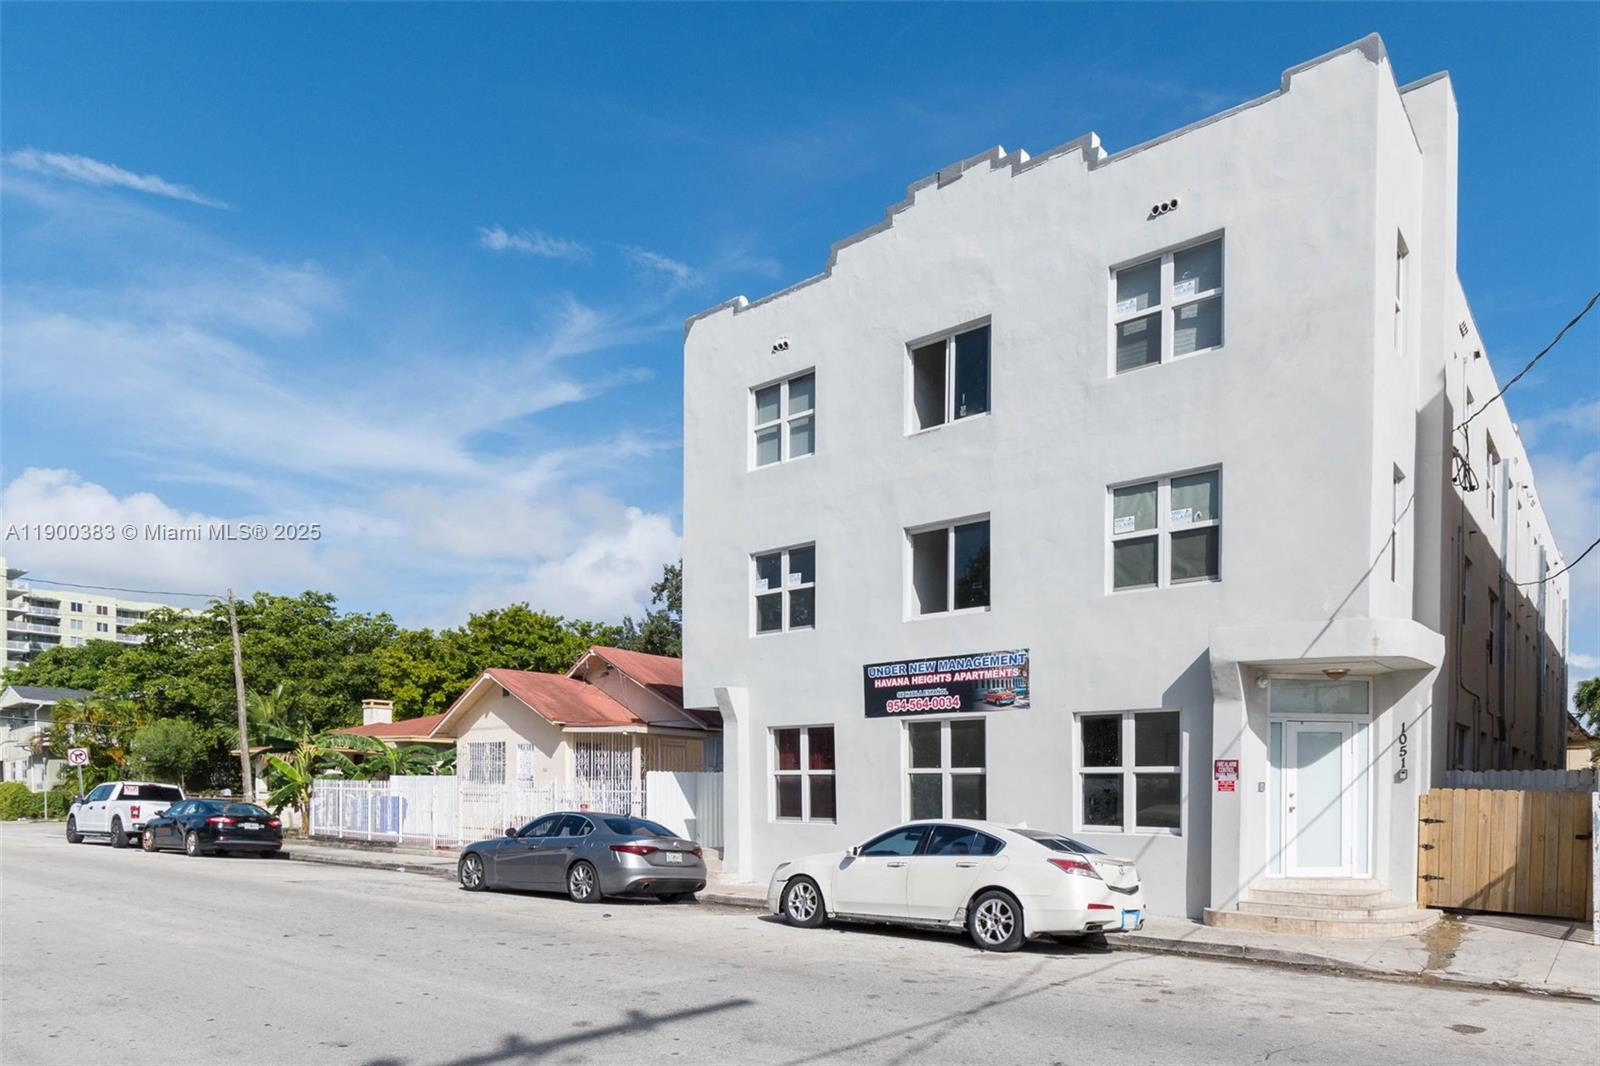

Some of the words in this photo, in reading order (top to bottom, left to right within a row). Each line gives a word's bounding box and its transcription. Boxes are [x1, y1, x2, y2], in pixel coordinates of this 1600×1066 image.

[868, 664, 906, 678] UNDER
[909, 661, 936, 675] NEW
[938, 653, 1026, 671] MANAGEMENT
[874, 677, 910, 688] HAVANA
[911, 673, 952, 685] HEIGHTS
[953, 668, 1019, 682] APARTMENTS
[886, 695, 960, 713] 954-564-0034
[1399, 722, 1408, 768] 1051
